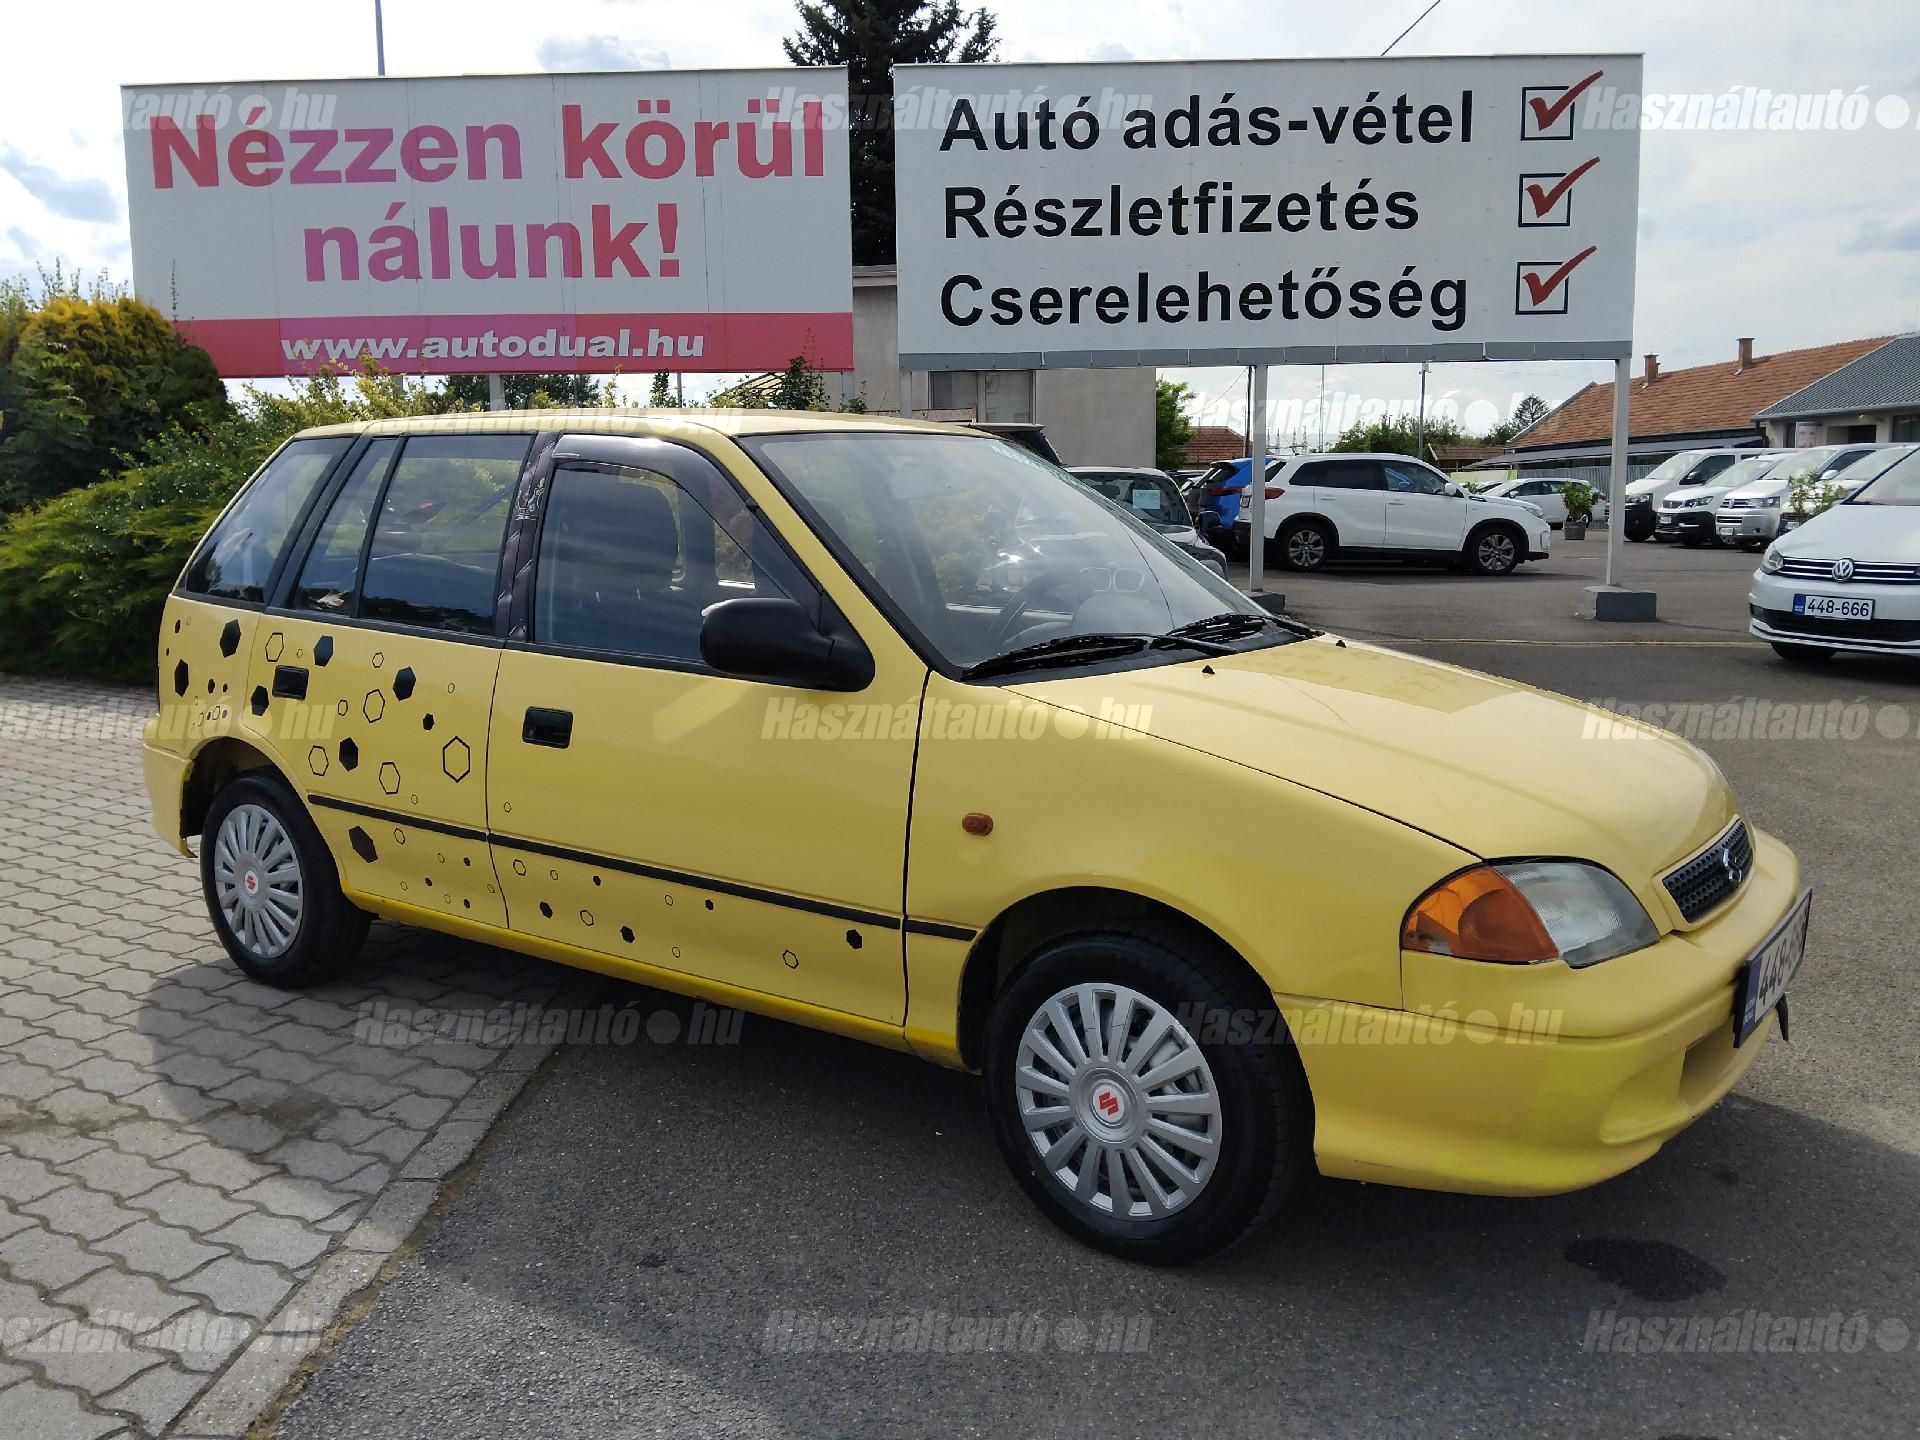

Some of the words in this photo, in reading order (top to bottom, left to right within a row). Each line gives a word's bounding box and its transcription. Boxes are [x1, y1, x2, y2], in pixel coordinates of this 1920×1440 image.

[151, 106, 521, 189] Nézzen
[562, 98, 824, 179] körül
[940, 95, 1100, 152] Autó
[1123, 89, 1473, 150] adás-vétel
[945, 177, 1419, 239] Részletfizetés
[304, 202, 680, 281] nálunk!
[940, 265, 1467, 331] Cserelehetőség
[281, 328, 704, 359] www.autodual.hu
[1807, 598, 1869, 616] 448-666
